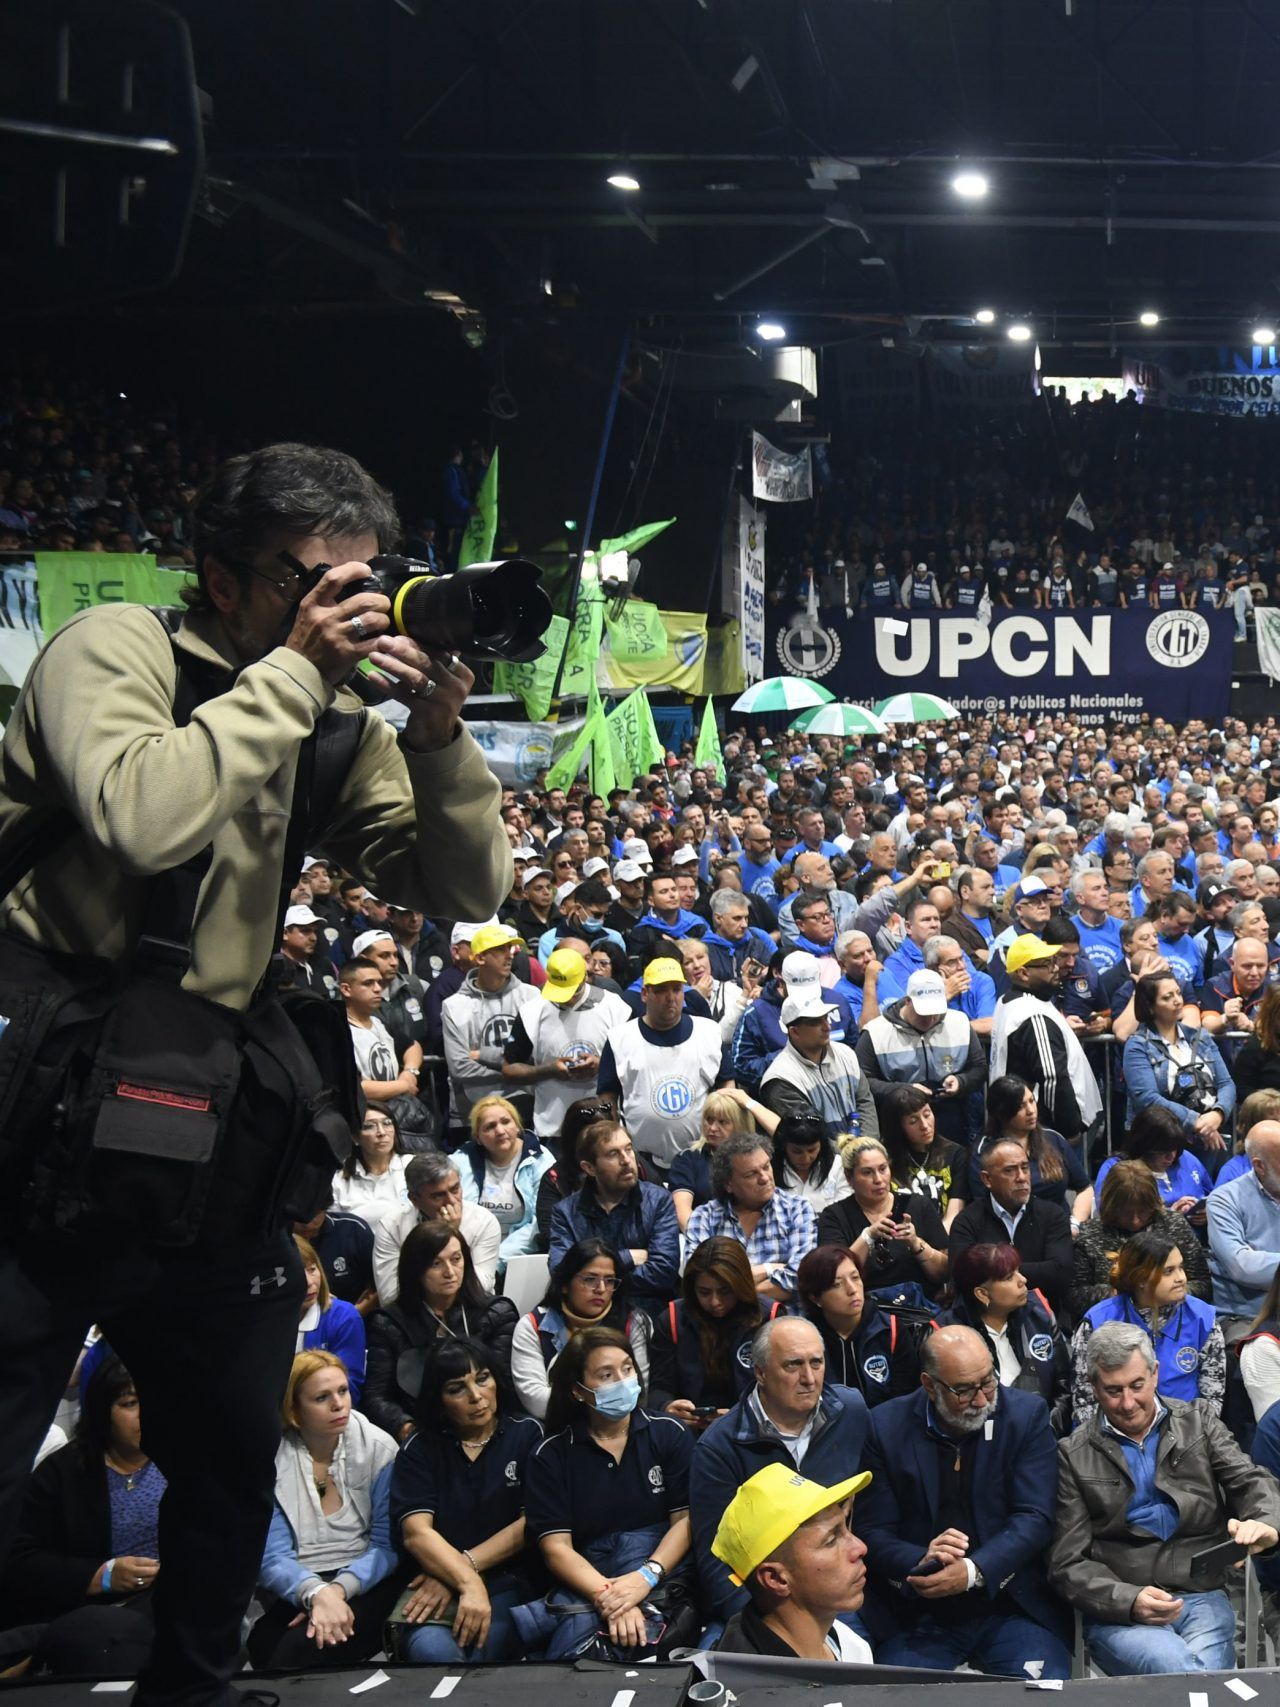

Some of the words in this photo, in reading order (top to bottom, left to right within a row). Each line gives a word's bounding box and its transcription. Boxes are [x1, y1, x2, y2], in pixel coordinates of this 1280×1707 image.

[1188, 376, 1273, 397] BUENOS
[874, 615, 1112, 678] UPCN
[1010, 694, 1066, 709] Públicos
[1070, 693, 1143, 708] Nacionales
[1058, 711, 1104, 725] Benos
[661, 1083, 690, 1112] CGT
